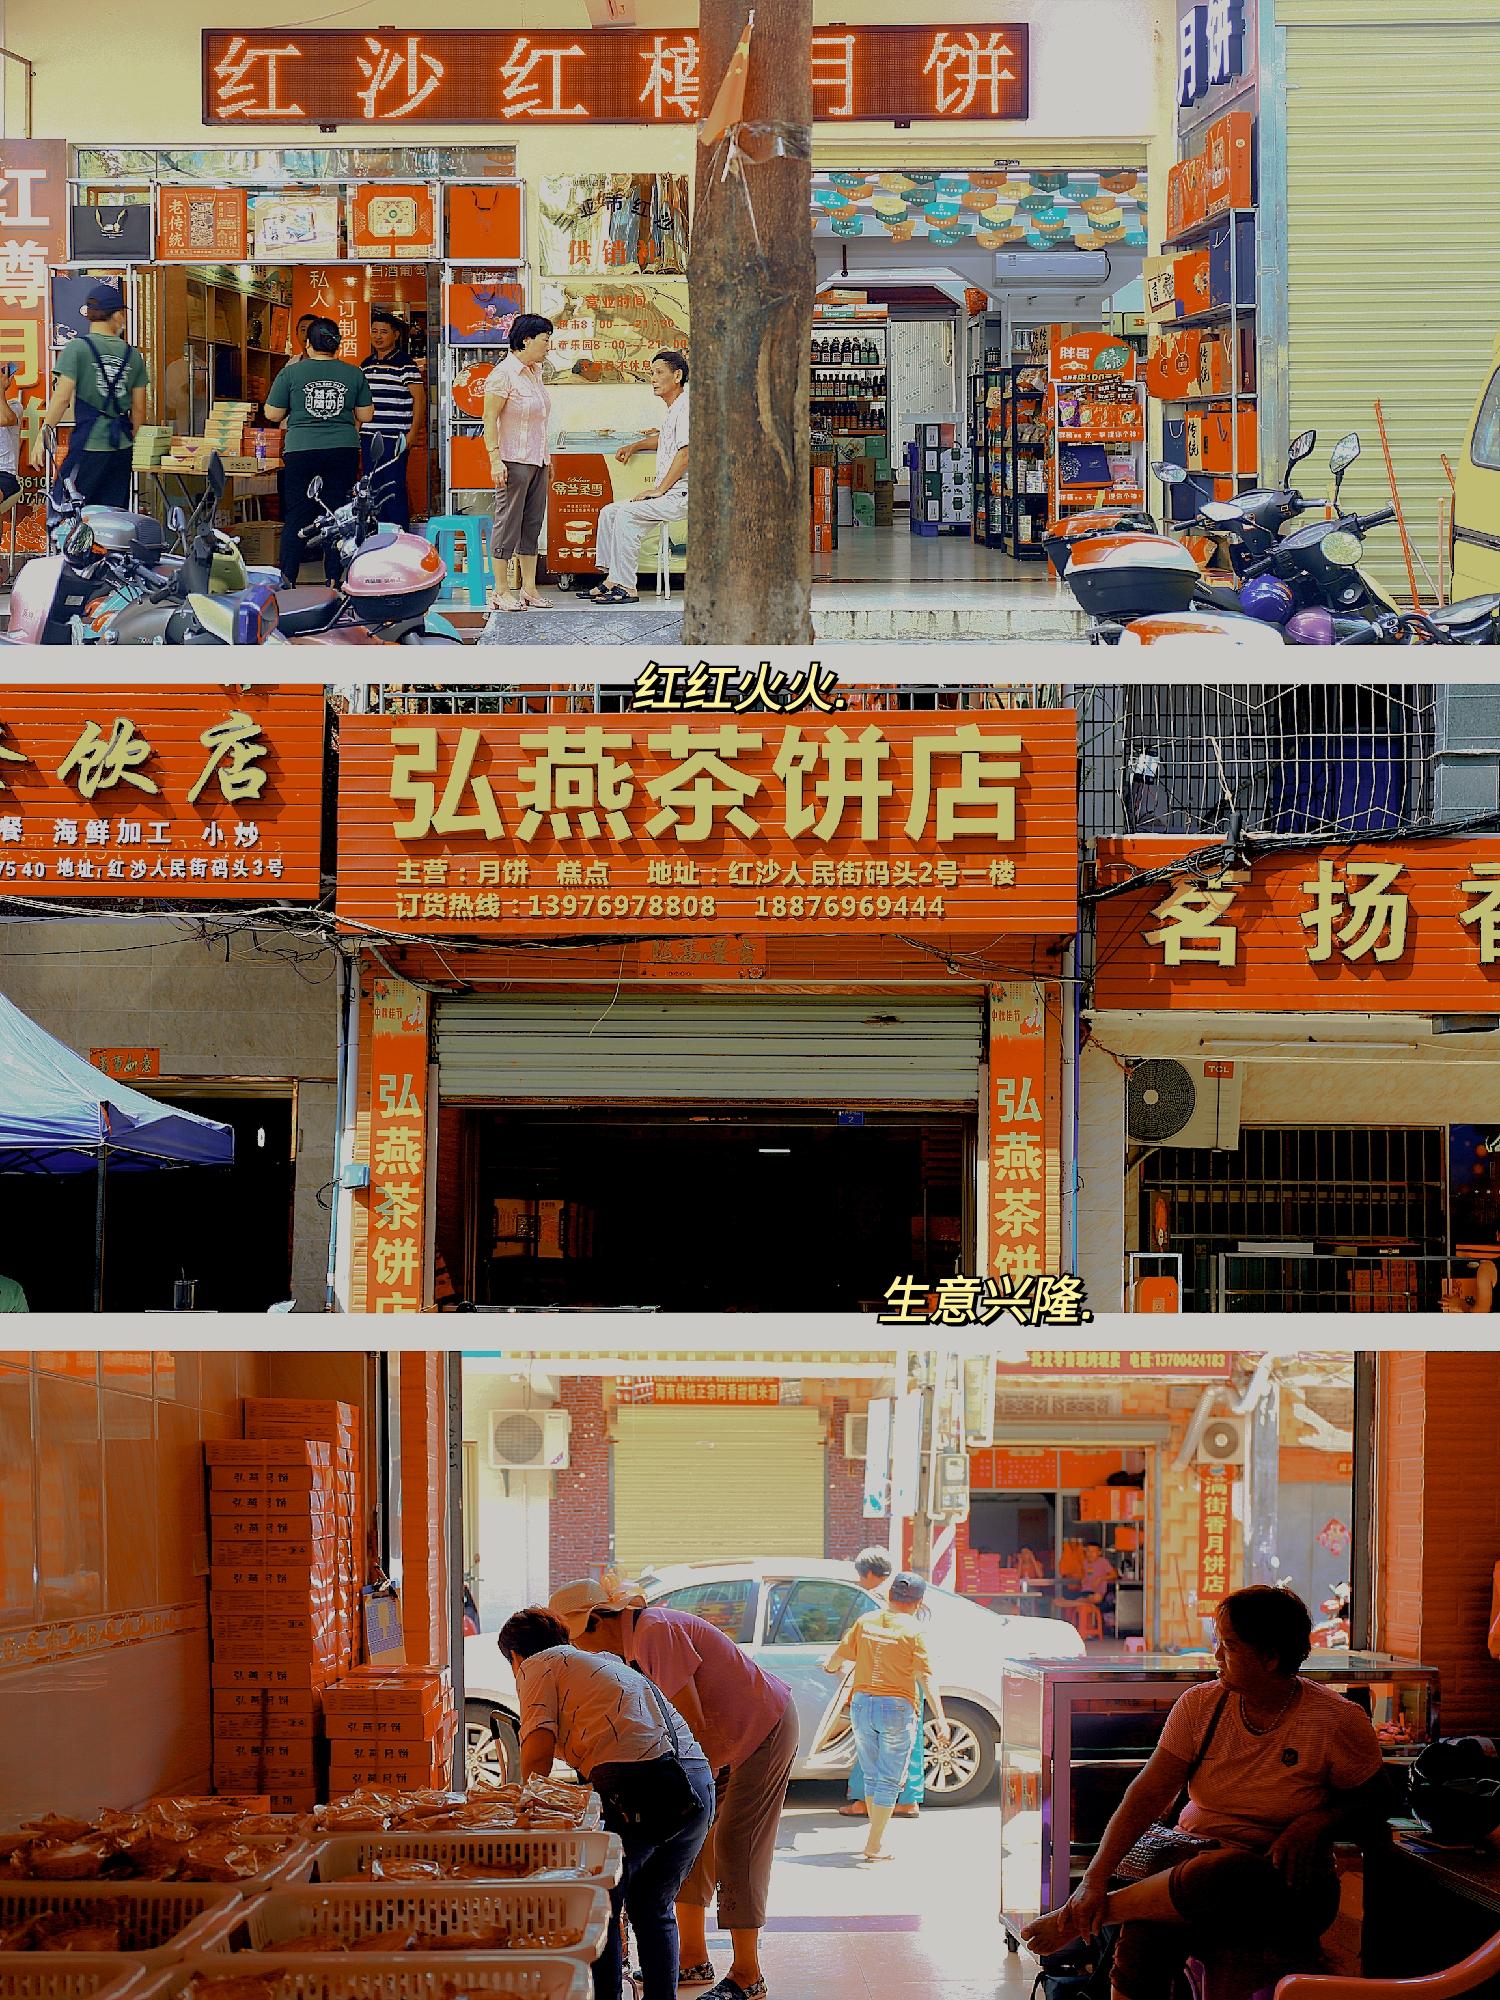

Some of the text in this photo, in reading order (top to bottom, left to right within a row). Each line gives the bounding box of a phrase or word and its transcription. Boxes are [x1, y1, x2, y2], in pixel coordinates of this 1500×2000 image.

[586, 294, 647, 309] 营业时间
[389, 723, 1023, 844] 弘燕茶饼店
[53, 818, 172, 846] 海鲜加工
[201, 821, 259, 847] 小炒
[395, 859, 530, 886] 主营：月饼
[556, 859, 610, 886] 糕点
[755, 895, 946, 917] 18876969444
[1208, 1065, 1230, 1074] TCL
